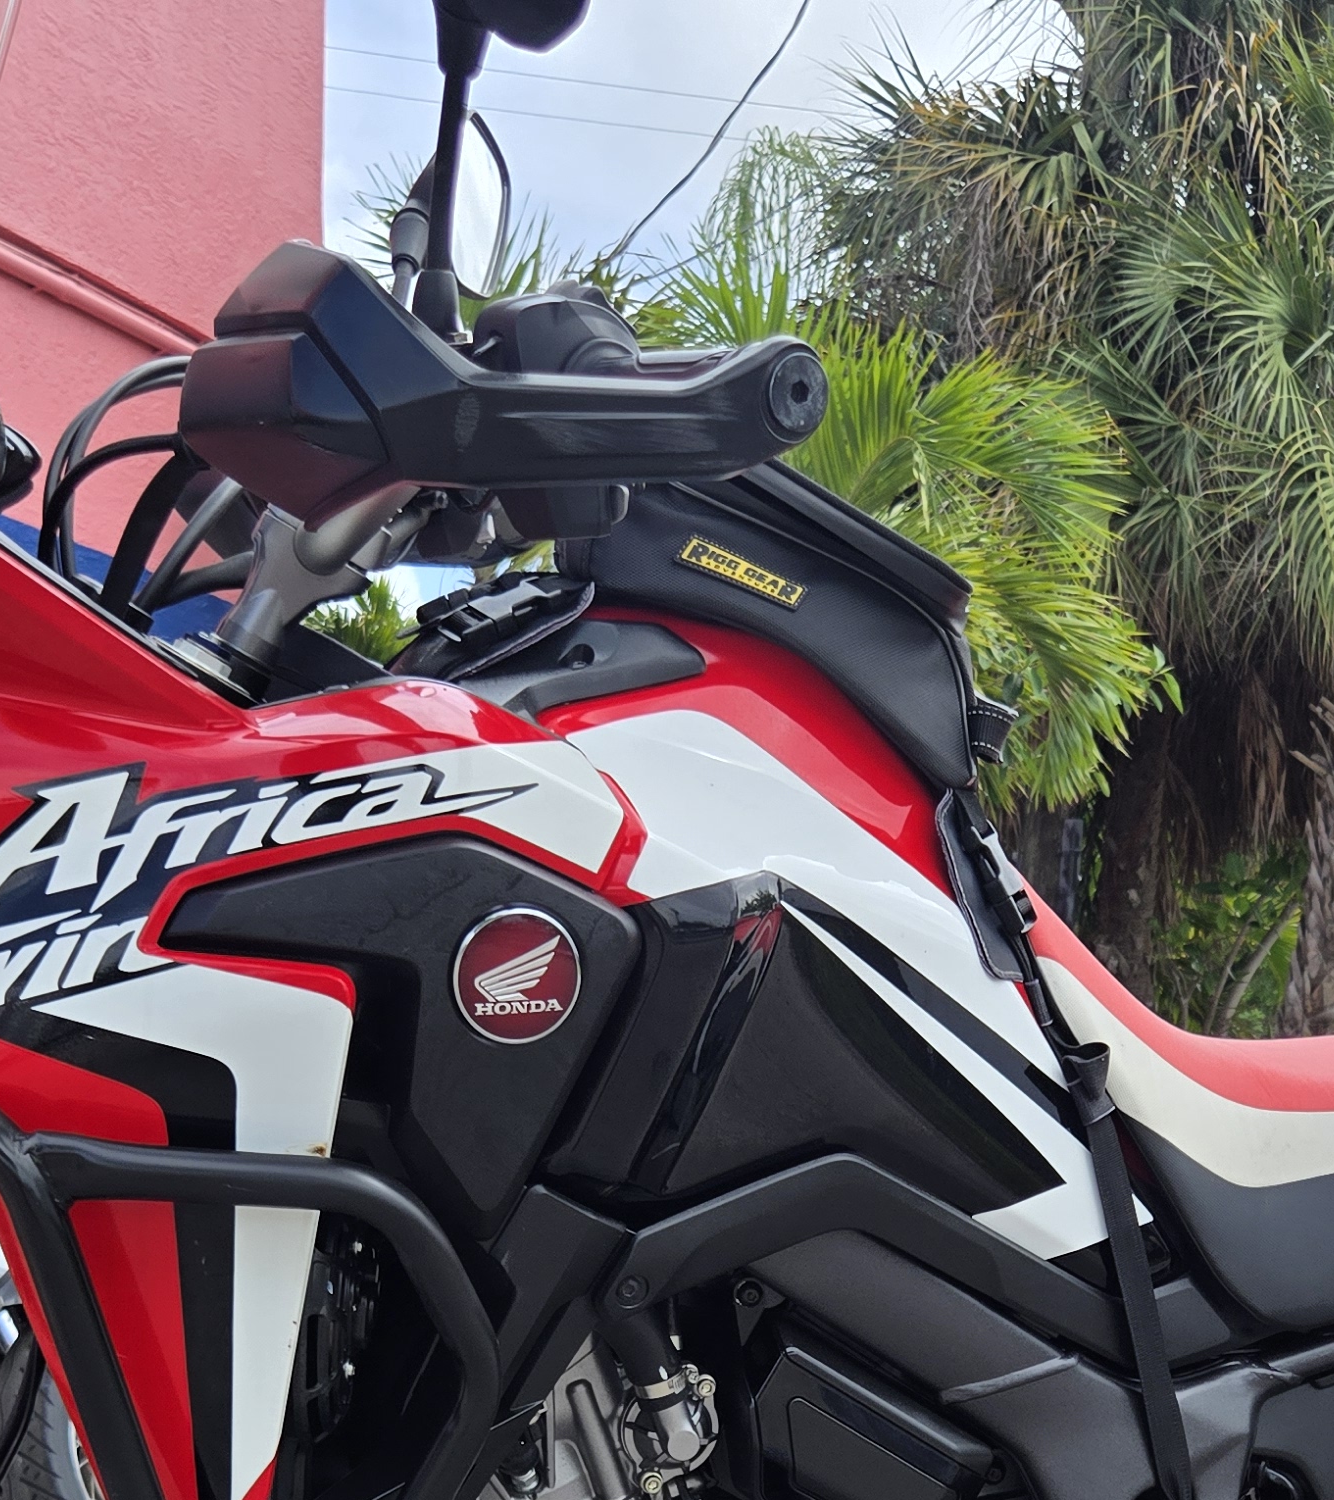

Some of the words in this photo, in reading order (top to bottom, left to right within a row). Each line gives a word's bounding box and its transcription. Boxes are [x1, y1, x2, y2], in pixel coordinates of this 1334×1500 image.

[686, 541, 742, 571] RIGG
[744, 567, 798, 602] GEAR
[474, 998, 564, 1016] HONDA
